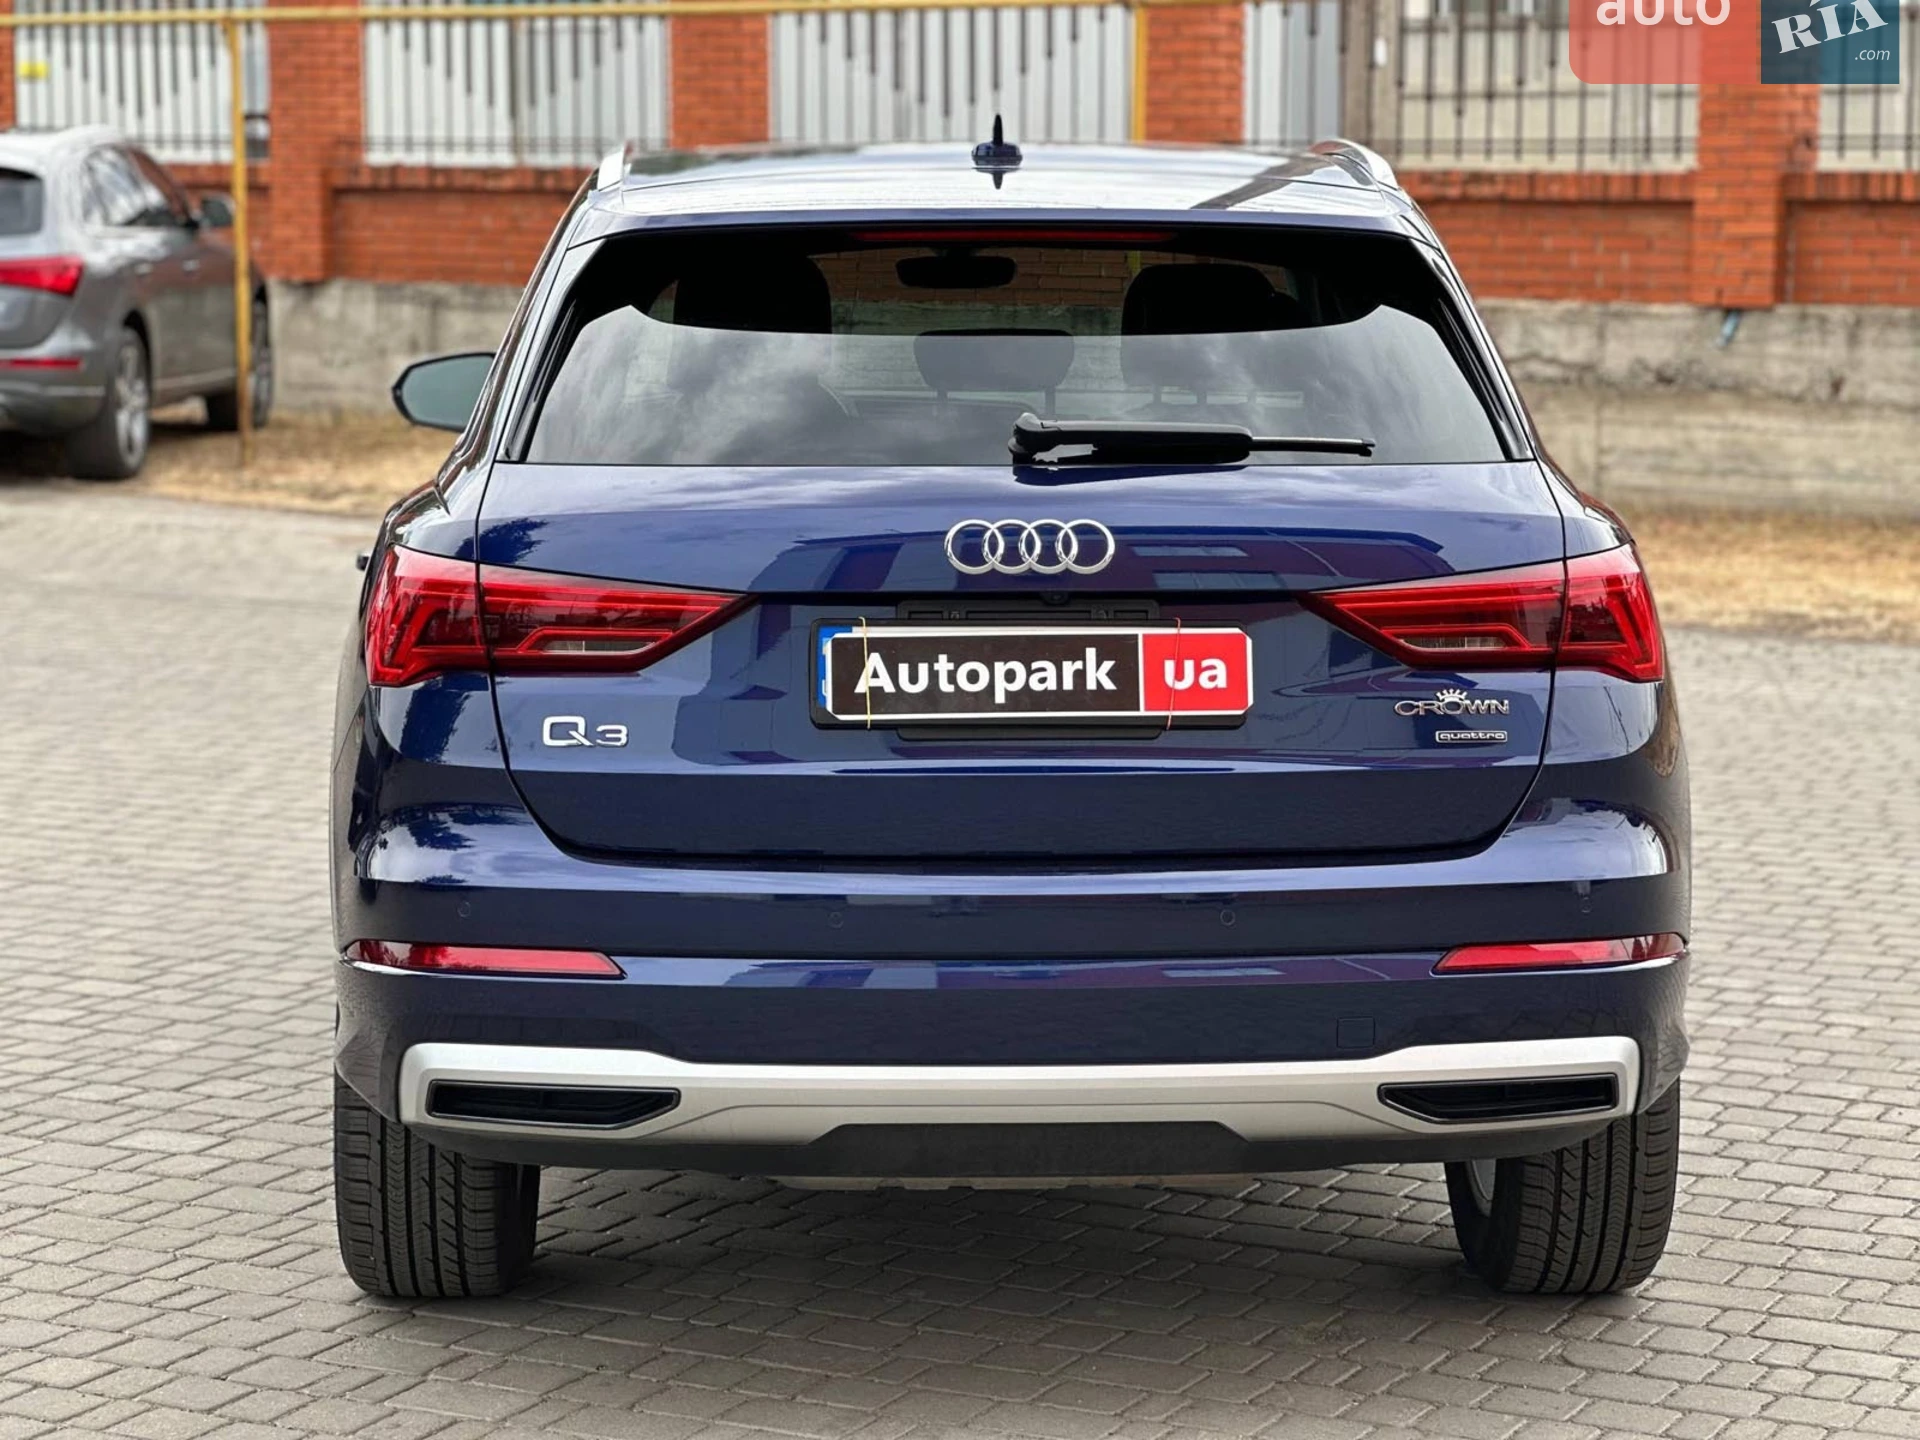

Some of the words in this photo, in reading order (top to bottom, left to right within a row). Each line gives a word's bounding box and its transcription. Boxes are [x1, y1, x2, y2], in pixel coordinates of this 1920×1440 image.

[854, 647, 1118, 704] Autopark
[1163, 657, 1228, 690] ua
[1394, 698, 1510, 716] CROWN
[543, 716, 628, 747] Q3
[1440, 732, 1505, 741] quattro
